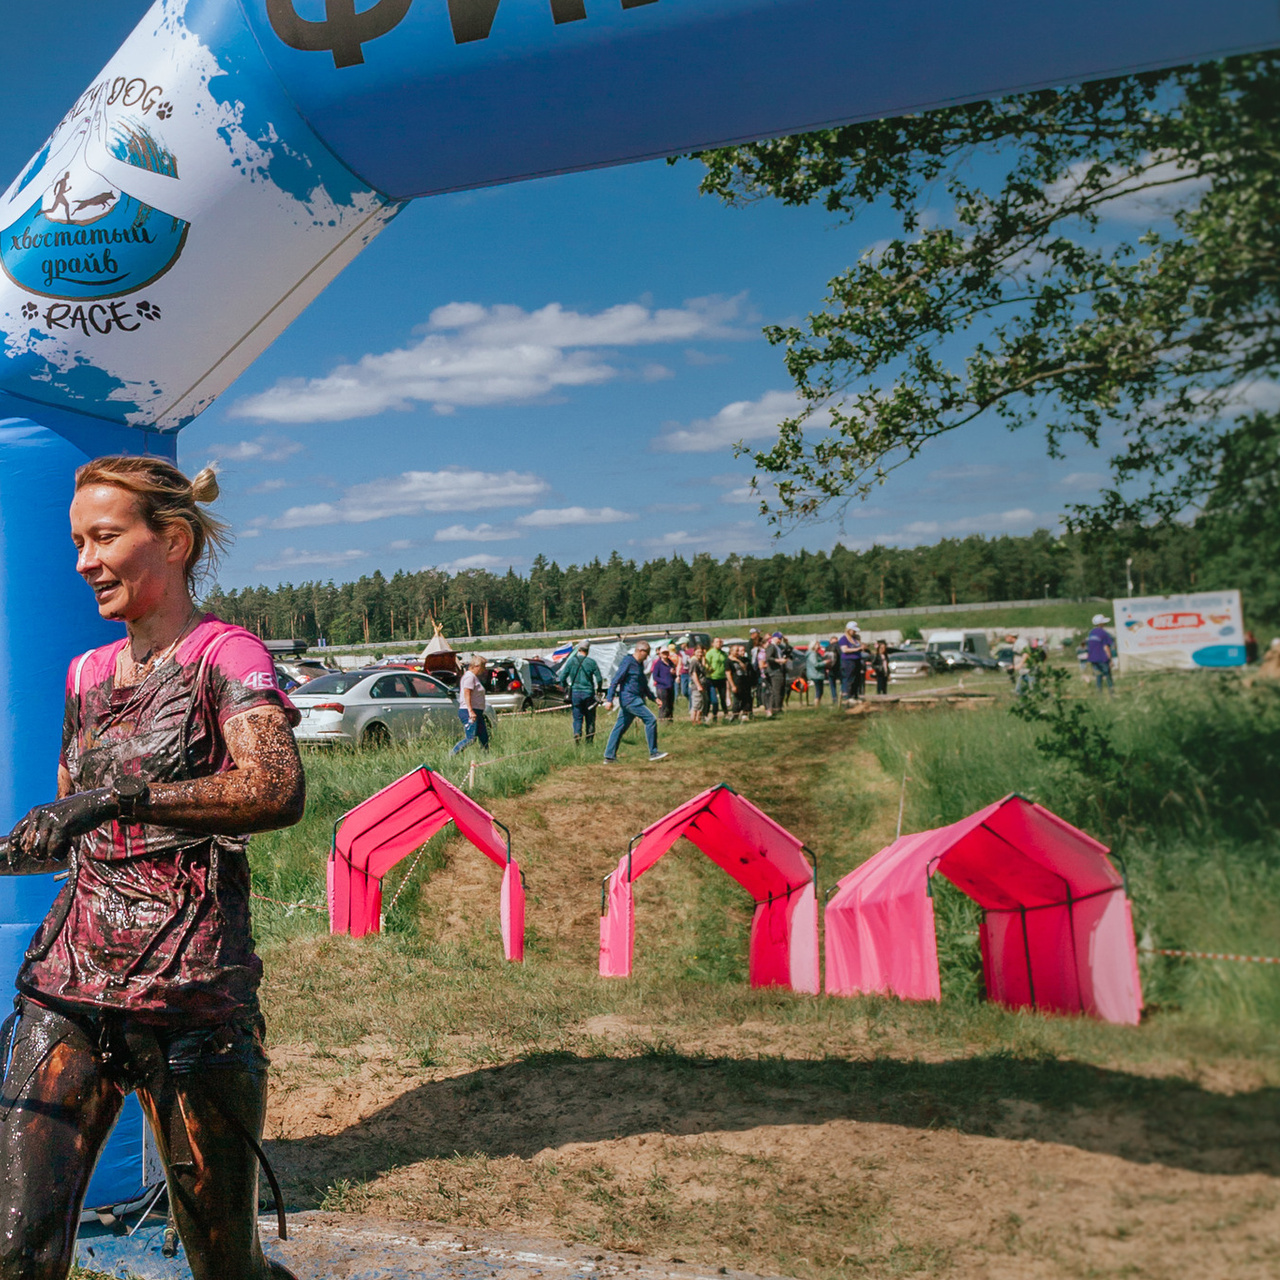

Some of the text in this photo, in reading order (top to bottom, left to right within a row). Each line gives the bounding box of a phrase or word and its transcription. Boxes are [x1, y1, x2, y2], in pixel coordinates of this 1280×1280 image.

[107, 76, 163, 115] DOG
[10, 221, 158, 251] хвостатый
[42, 248, 119, 287] драйв
[43, 301, 141, 337] RACE
